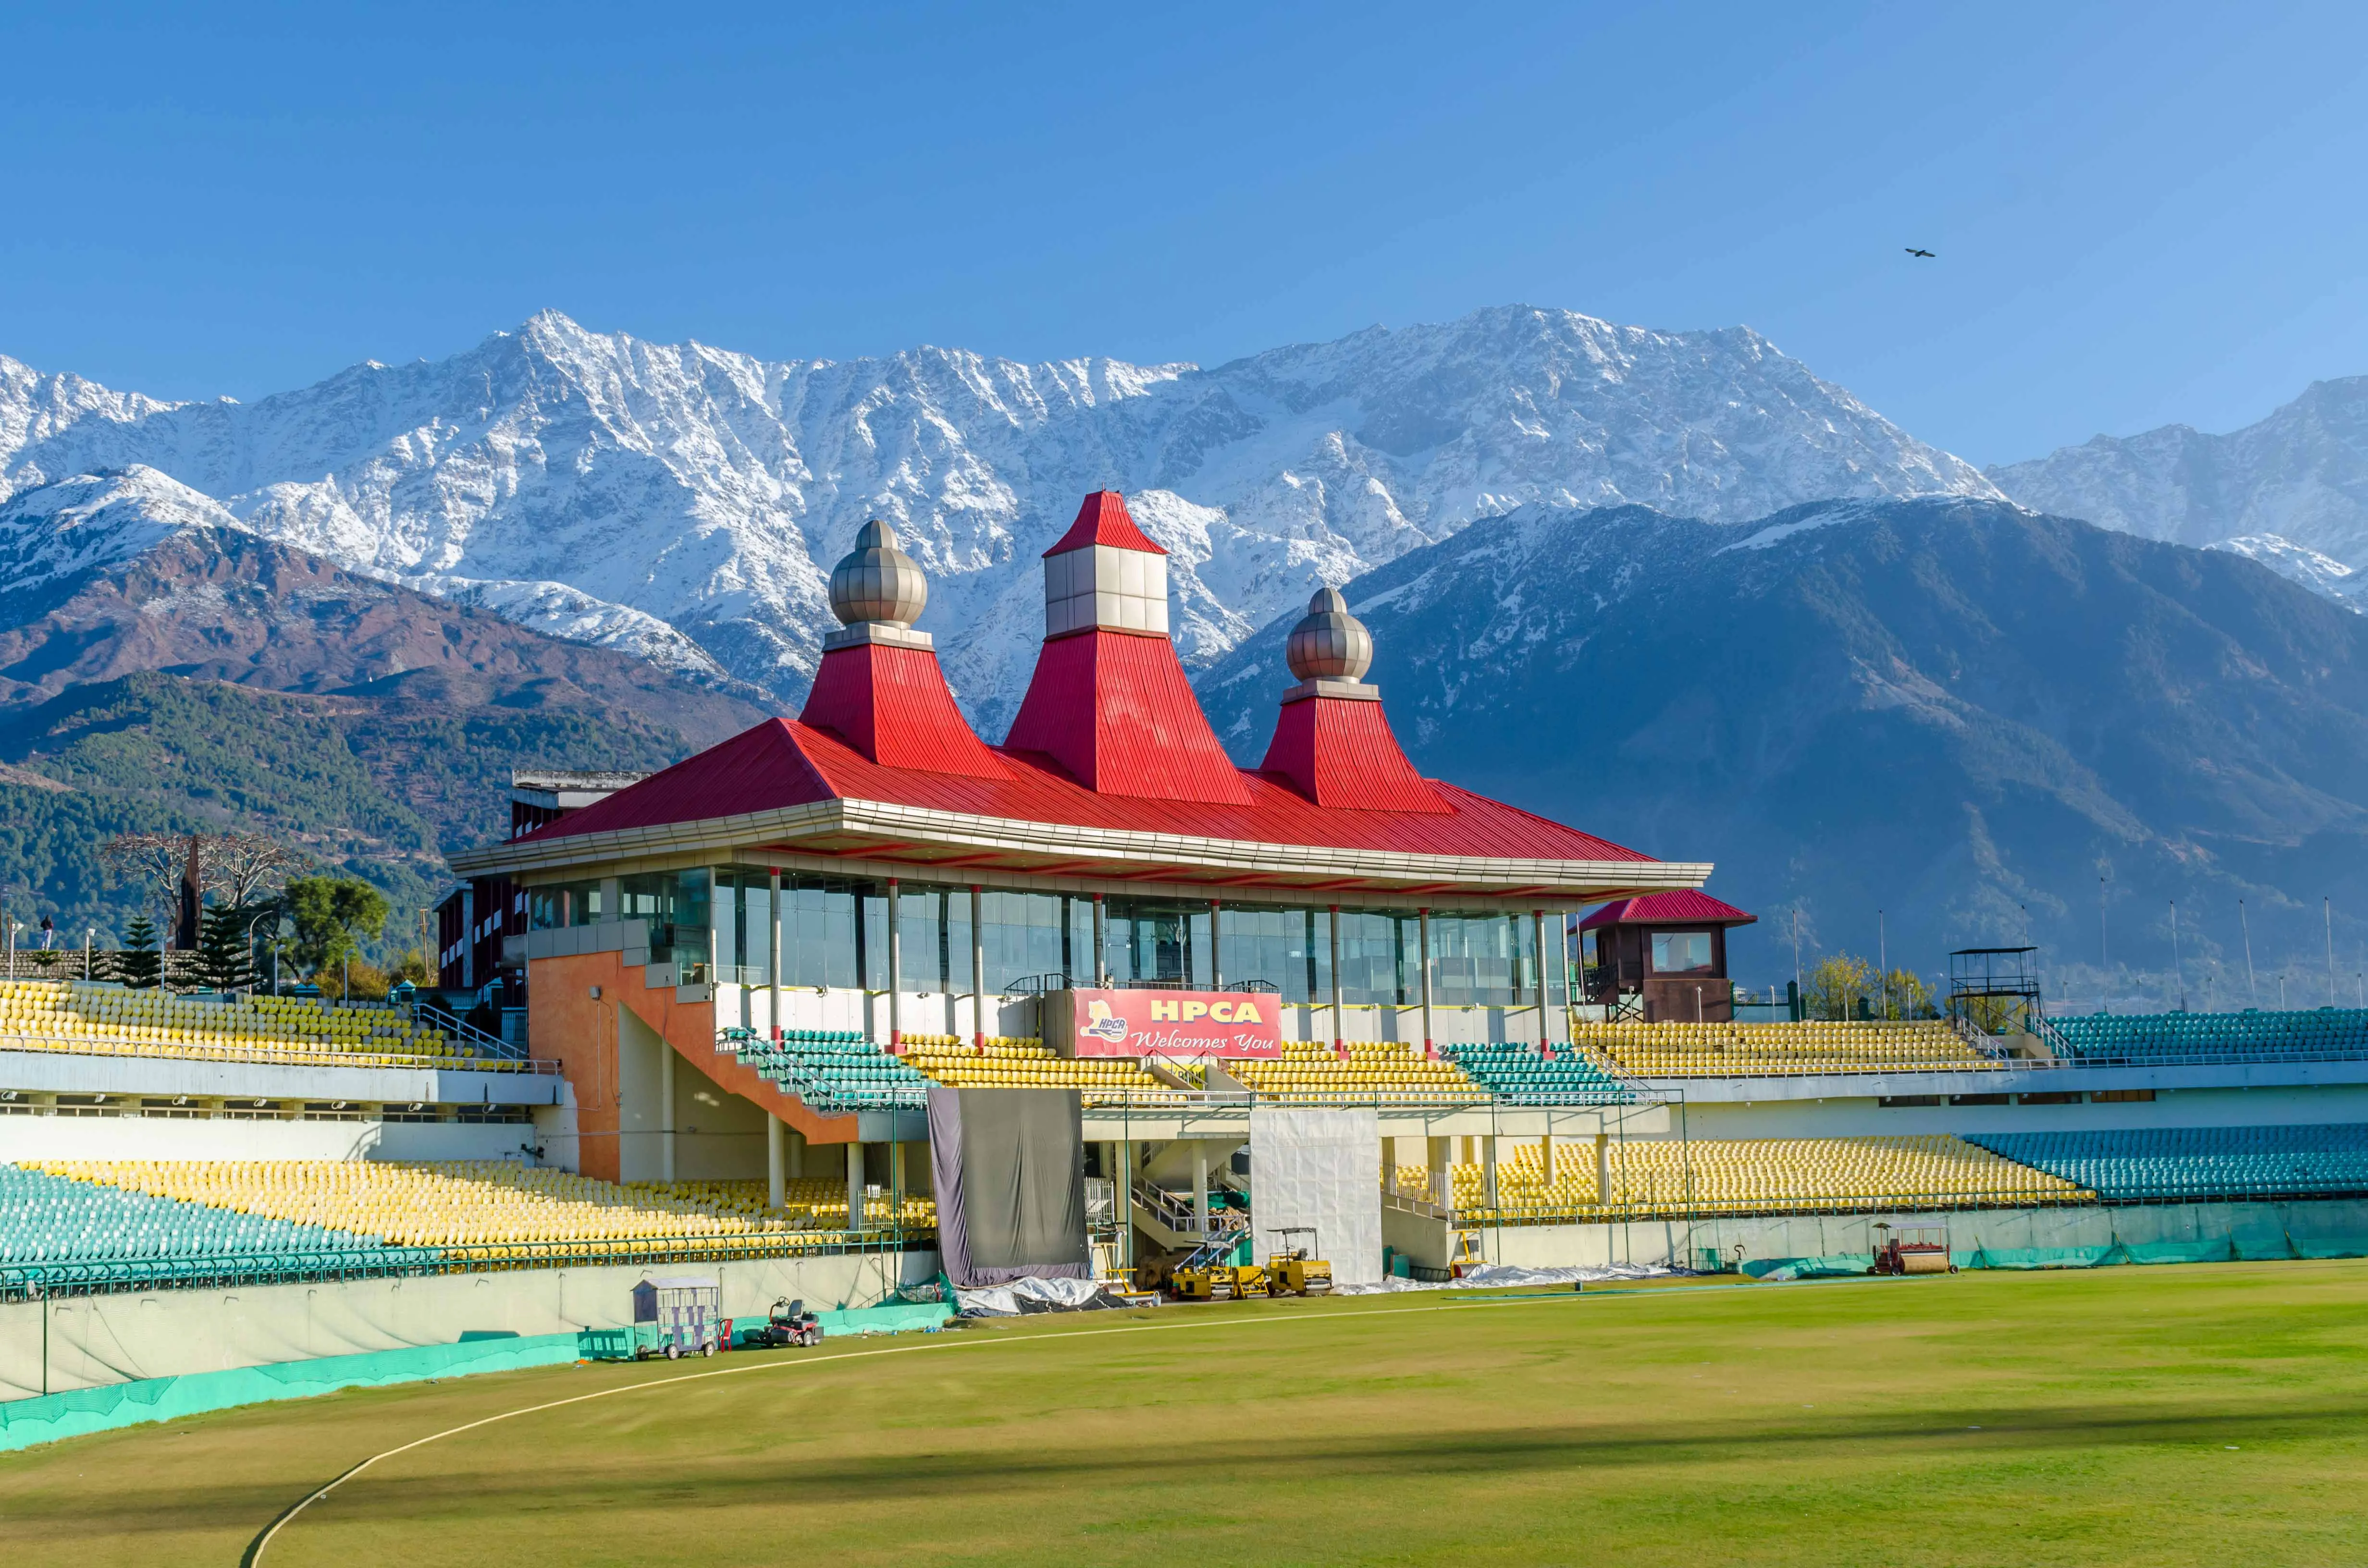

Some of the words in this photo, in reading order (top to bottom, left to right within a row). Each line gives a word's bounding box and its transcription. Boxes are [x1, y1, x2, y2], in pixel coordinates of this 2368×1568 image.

[1150, 1000, 1264, 1024] HPCA
[1098, 1018, 1126, 1029] HPCA
[1130, 1029, 1228, 1048] Welcomes
[1233, 1033, 1274, 1051] You
